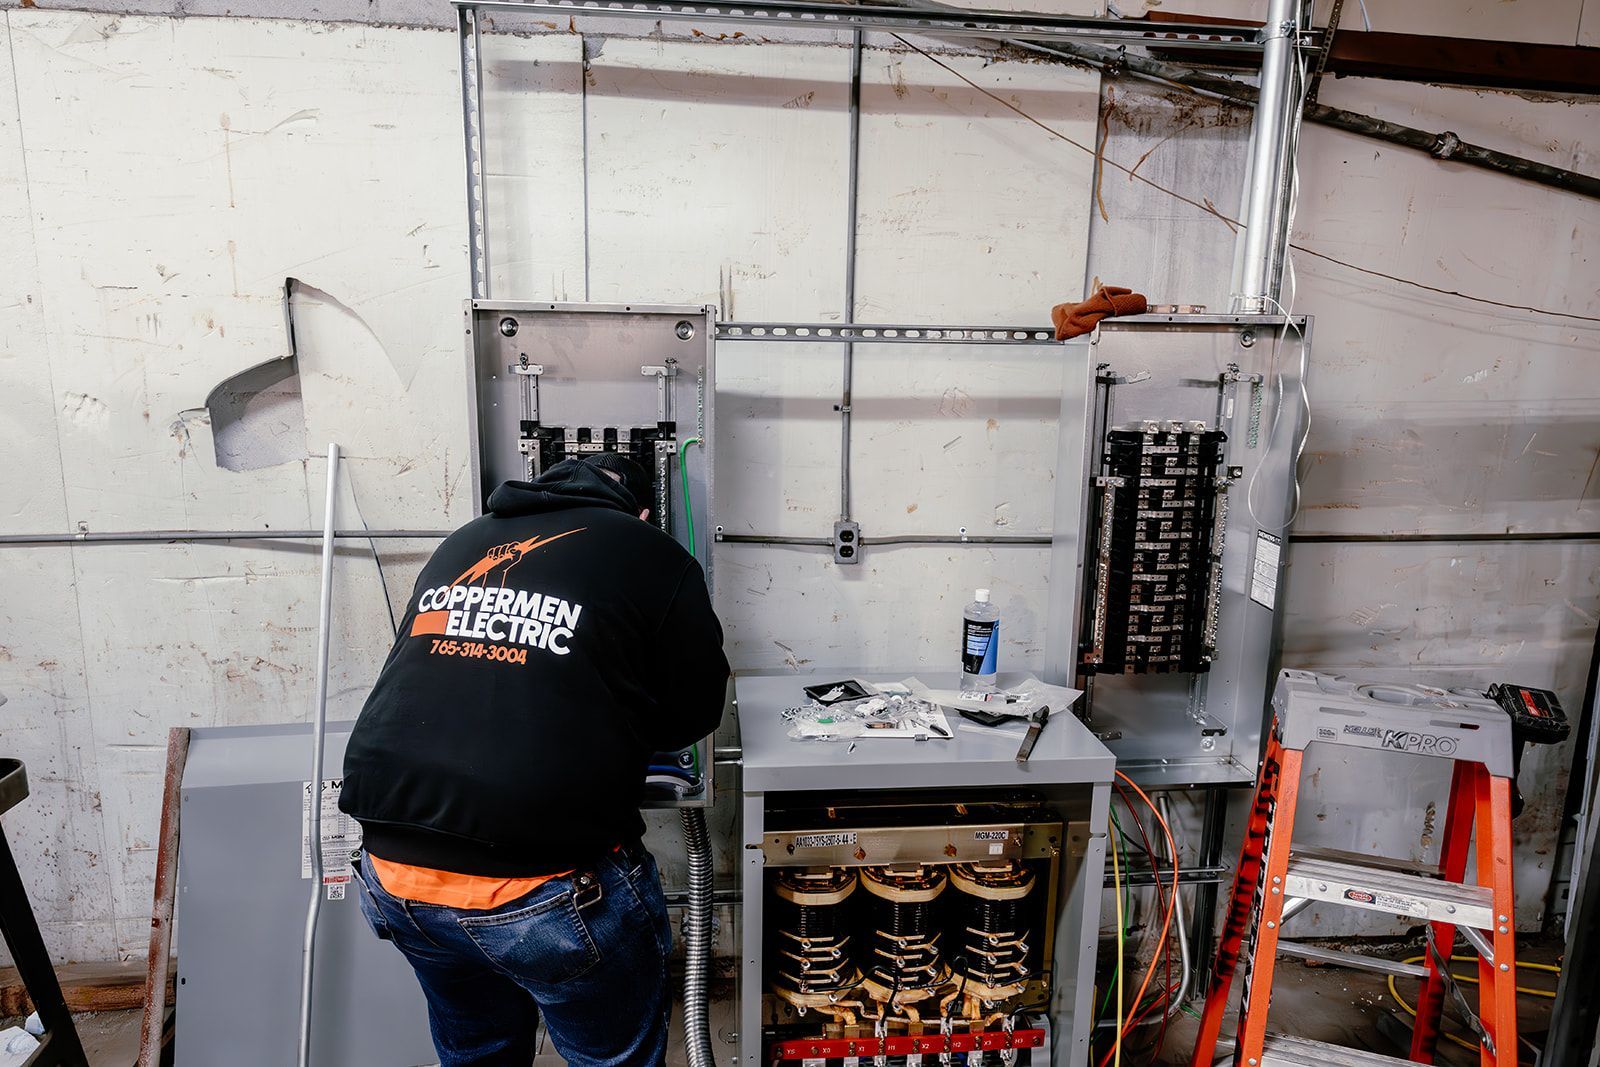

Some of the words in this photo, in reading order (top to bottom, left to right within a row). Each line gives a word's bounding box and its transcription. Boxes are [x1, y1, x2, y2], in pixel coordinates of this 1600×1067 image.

[418, 585, 582, 631] COPPERMEN
[445, 610, 574, 656] ELECTRIC
[430, 639, 528, 665] 765-314-3004
[1381, 729, 1457, 756] KPRO
